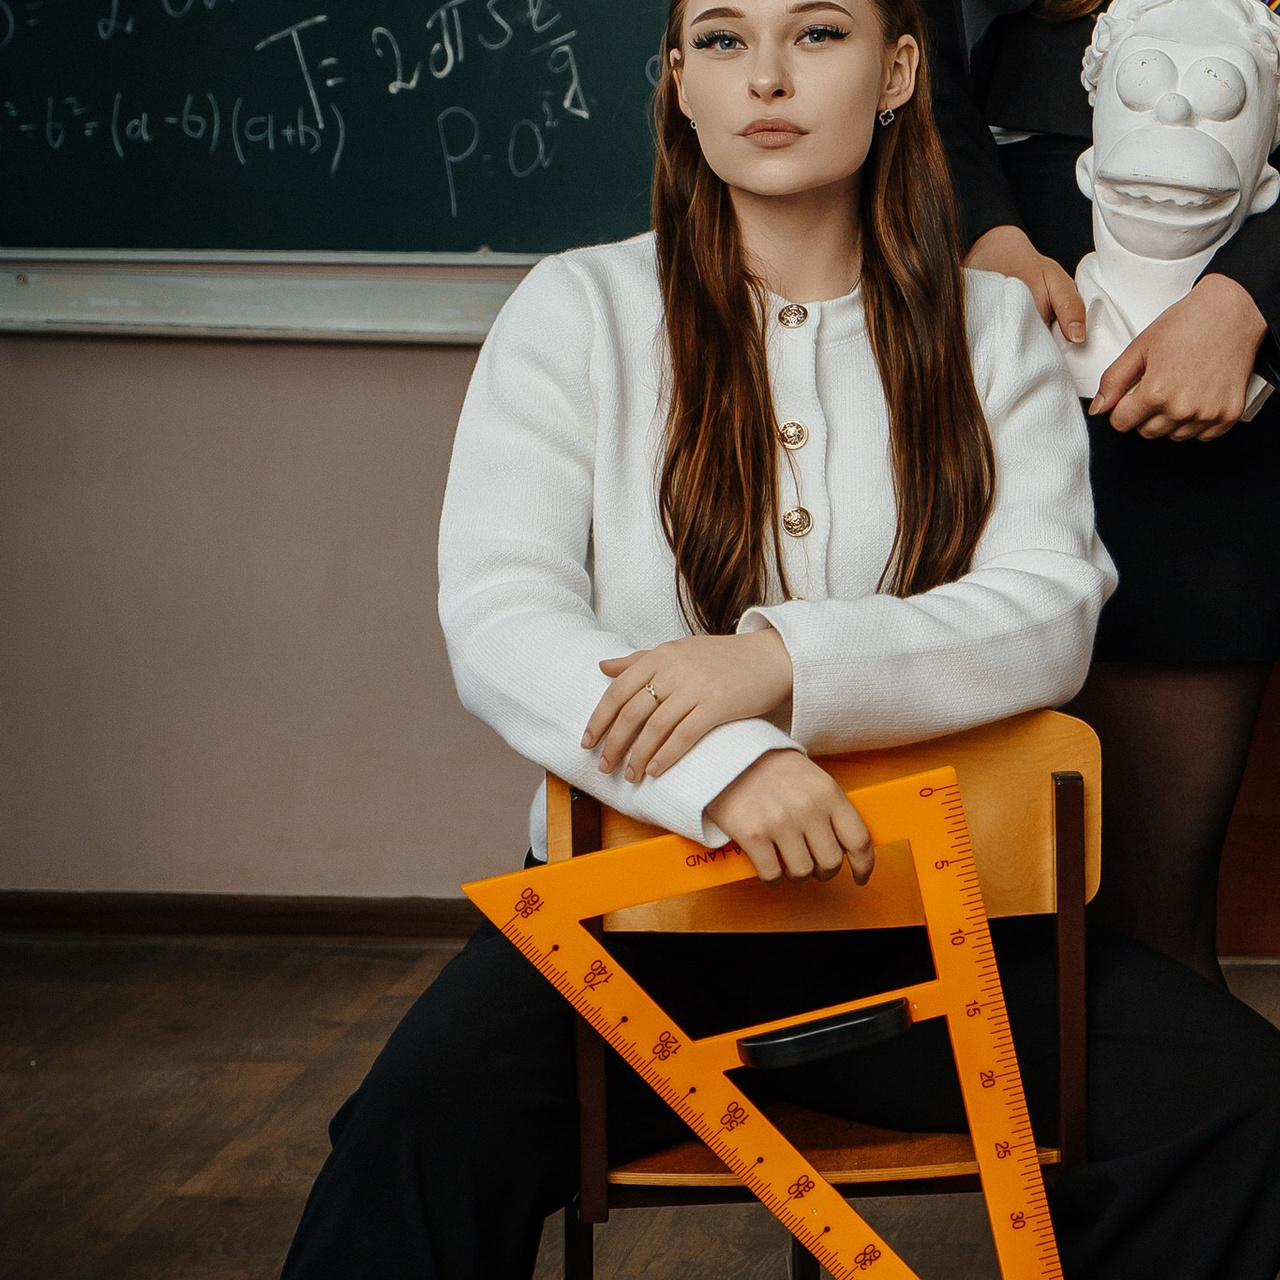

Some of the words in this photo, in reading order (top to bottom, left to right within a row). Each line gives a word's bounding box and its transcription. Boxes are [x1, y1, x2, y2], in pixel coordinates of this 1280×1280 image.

[919, 786, 934, 798] 0
[934, 858, 950, 870] 5
[514, 899, 534, 919] 80
[521, 887, 545, 912] 160
[950, 927, 966, 946] 10
[583, 971, 602, 991] 70
[590, 959, 614, 984] 140
[966, 999, 981, 1018] 15
[651, 1041, 671, 1062] 60
[658, 1030, 682, 1054] 120
[979, 1070, 996, 1089] 20
[720, 1113, 739, 1133] 50
[726, 1101, 750, 1126] 100
[994, 1140, 1011, 1160] 25
[787, 1182, 805, 1200] 40
[797, 1174, 816, 1192] 80
[1010, 1211, 1026, 1230] 30
[854, 1252, 873, 1271] 30
[863, 1243, 882, 1263] 60
